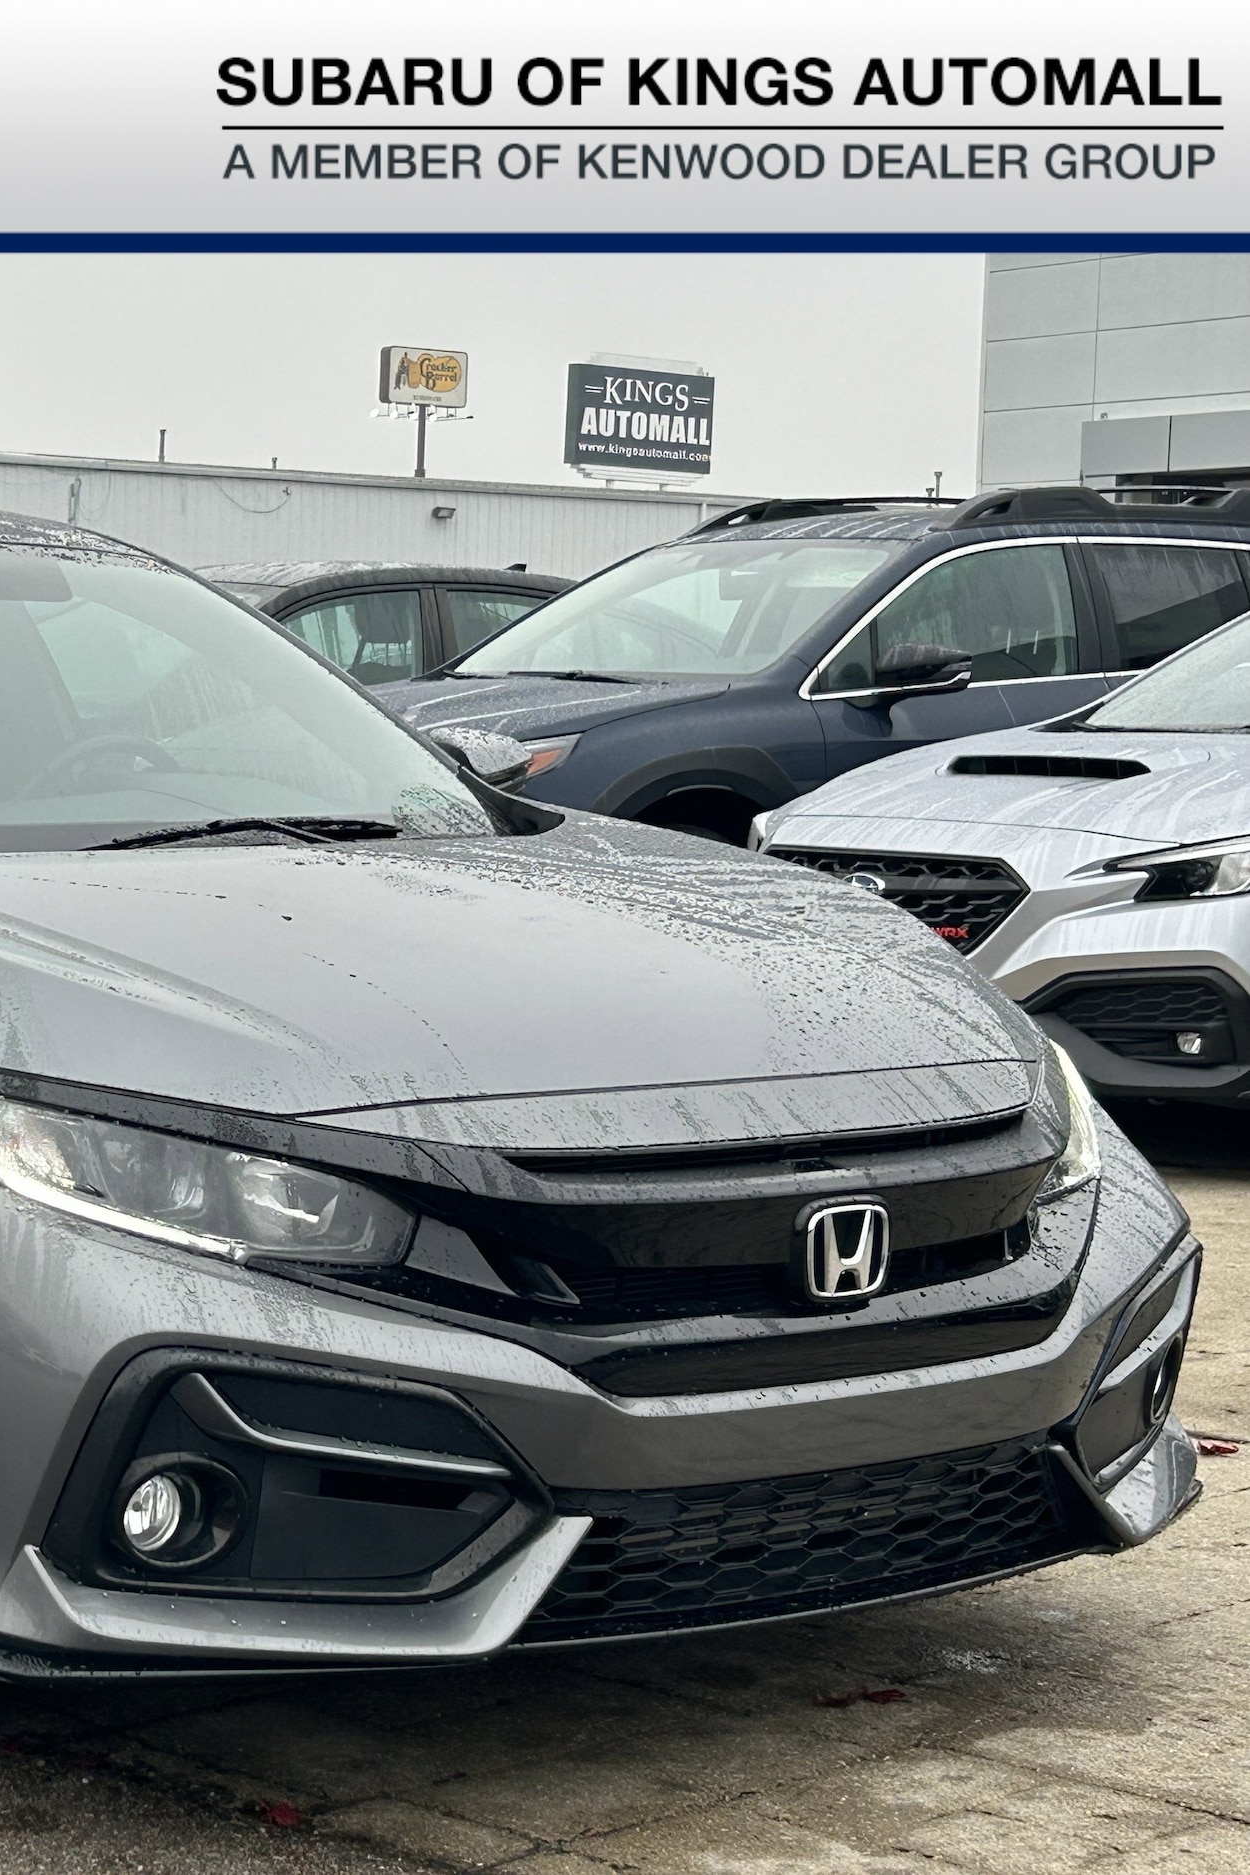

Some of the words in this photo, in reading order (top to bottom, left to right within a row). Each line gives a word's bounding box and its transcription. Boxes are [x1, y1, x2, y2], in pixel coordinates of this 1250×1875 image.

[426, 371, 457, 390] Barrel
[603, 376, 689, 411] KINGS
[580, 406, 710, 446] AUTOMALL
